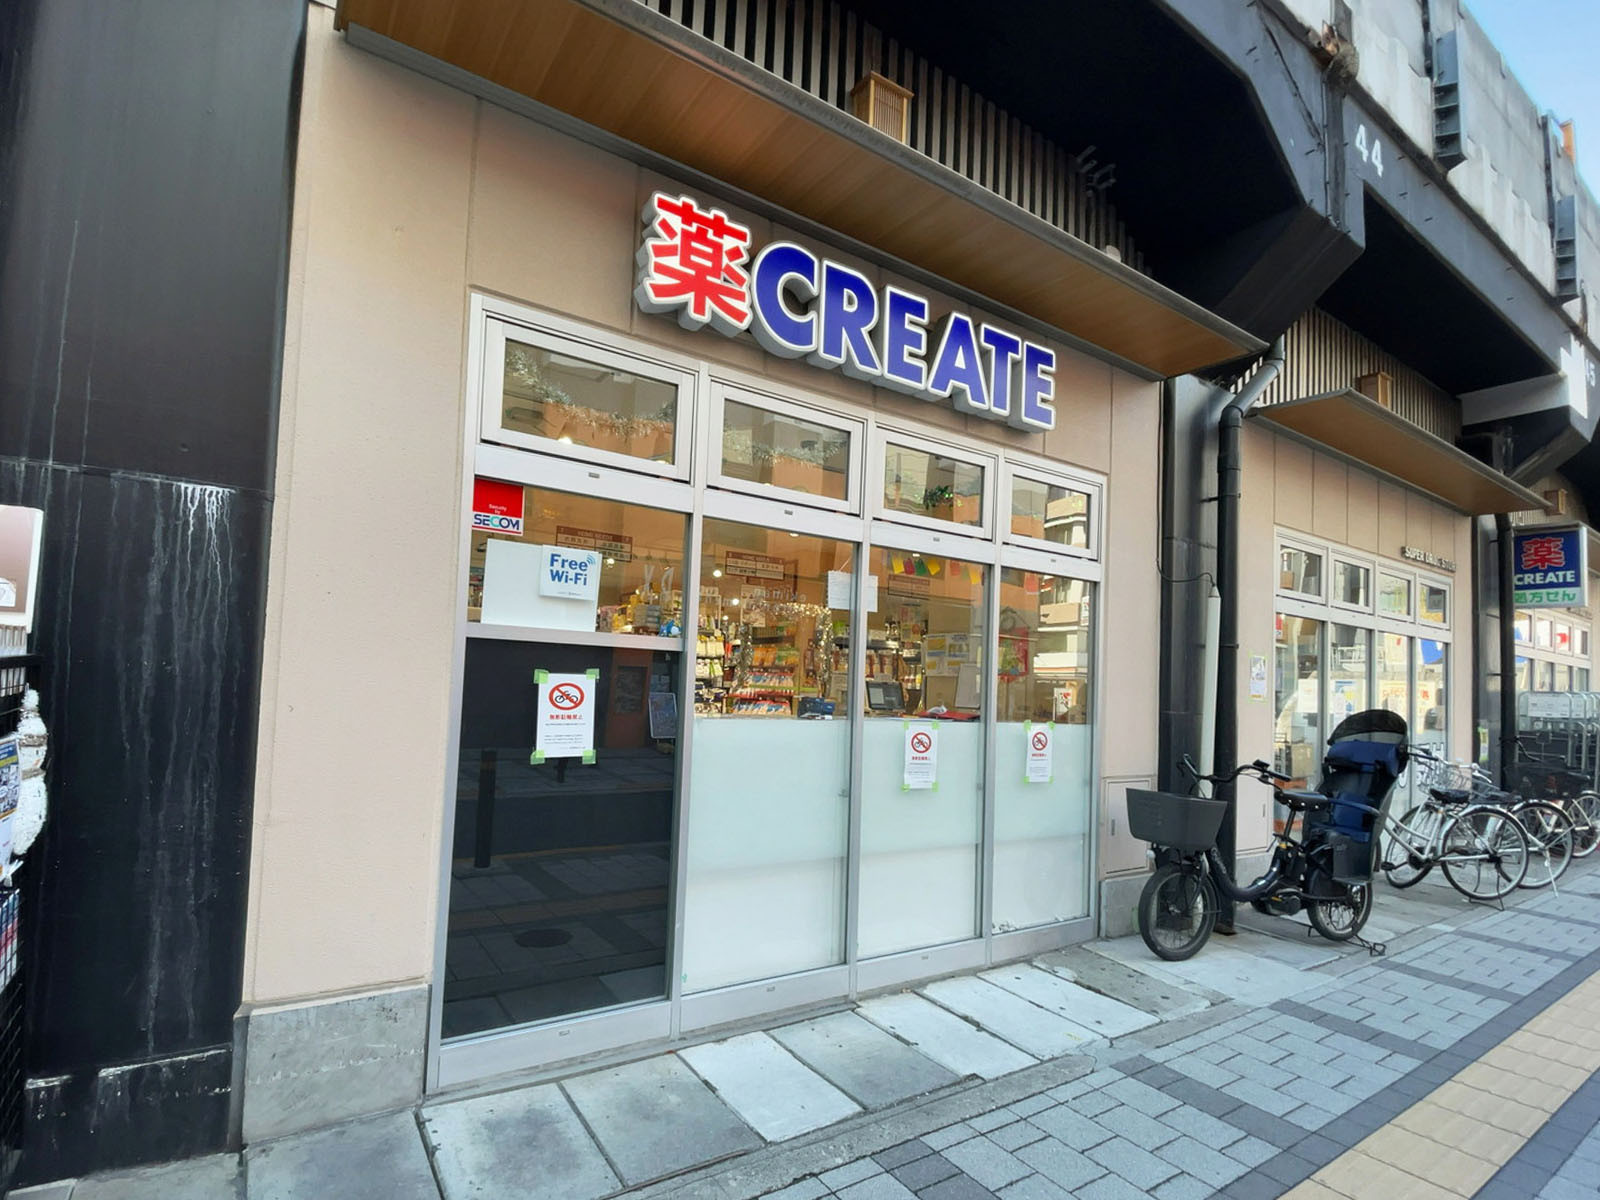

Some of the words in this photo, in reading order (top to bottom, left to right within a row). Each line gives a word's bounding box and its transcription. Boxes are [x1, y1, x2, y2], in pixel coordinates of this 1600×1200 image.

[1356, 124, 1384, 178] 44
[647, 191, 752, 331] 薬
[752, 242, 1056, 430] CREATE
[474, 513, 520, 530] SECOM
[549, 553, 589, 572] Free
[1521, 537, 1566, 570] 薬
[549, 569, 588, 586] Wi-Fi
[1514, 570, 1576, 585] CREATE
